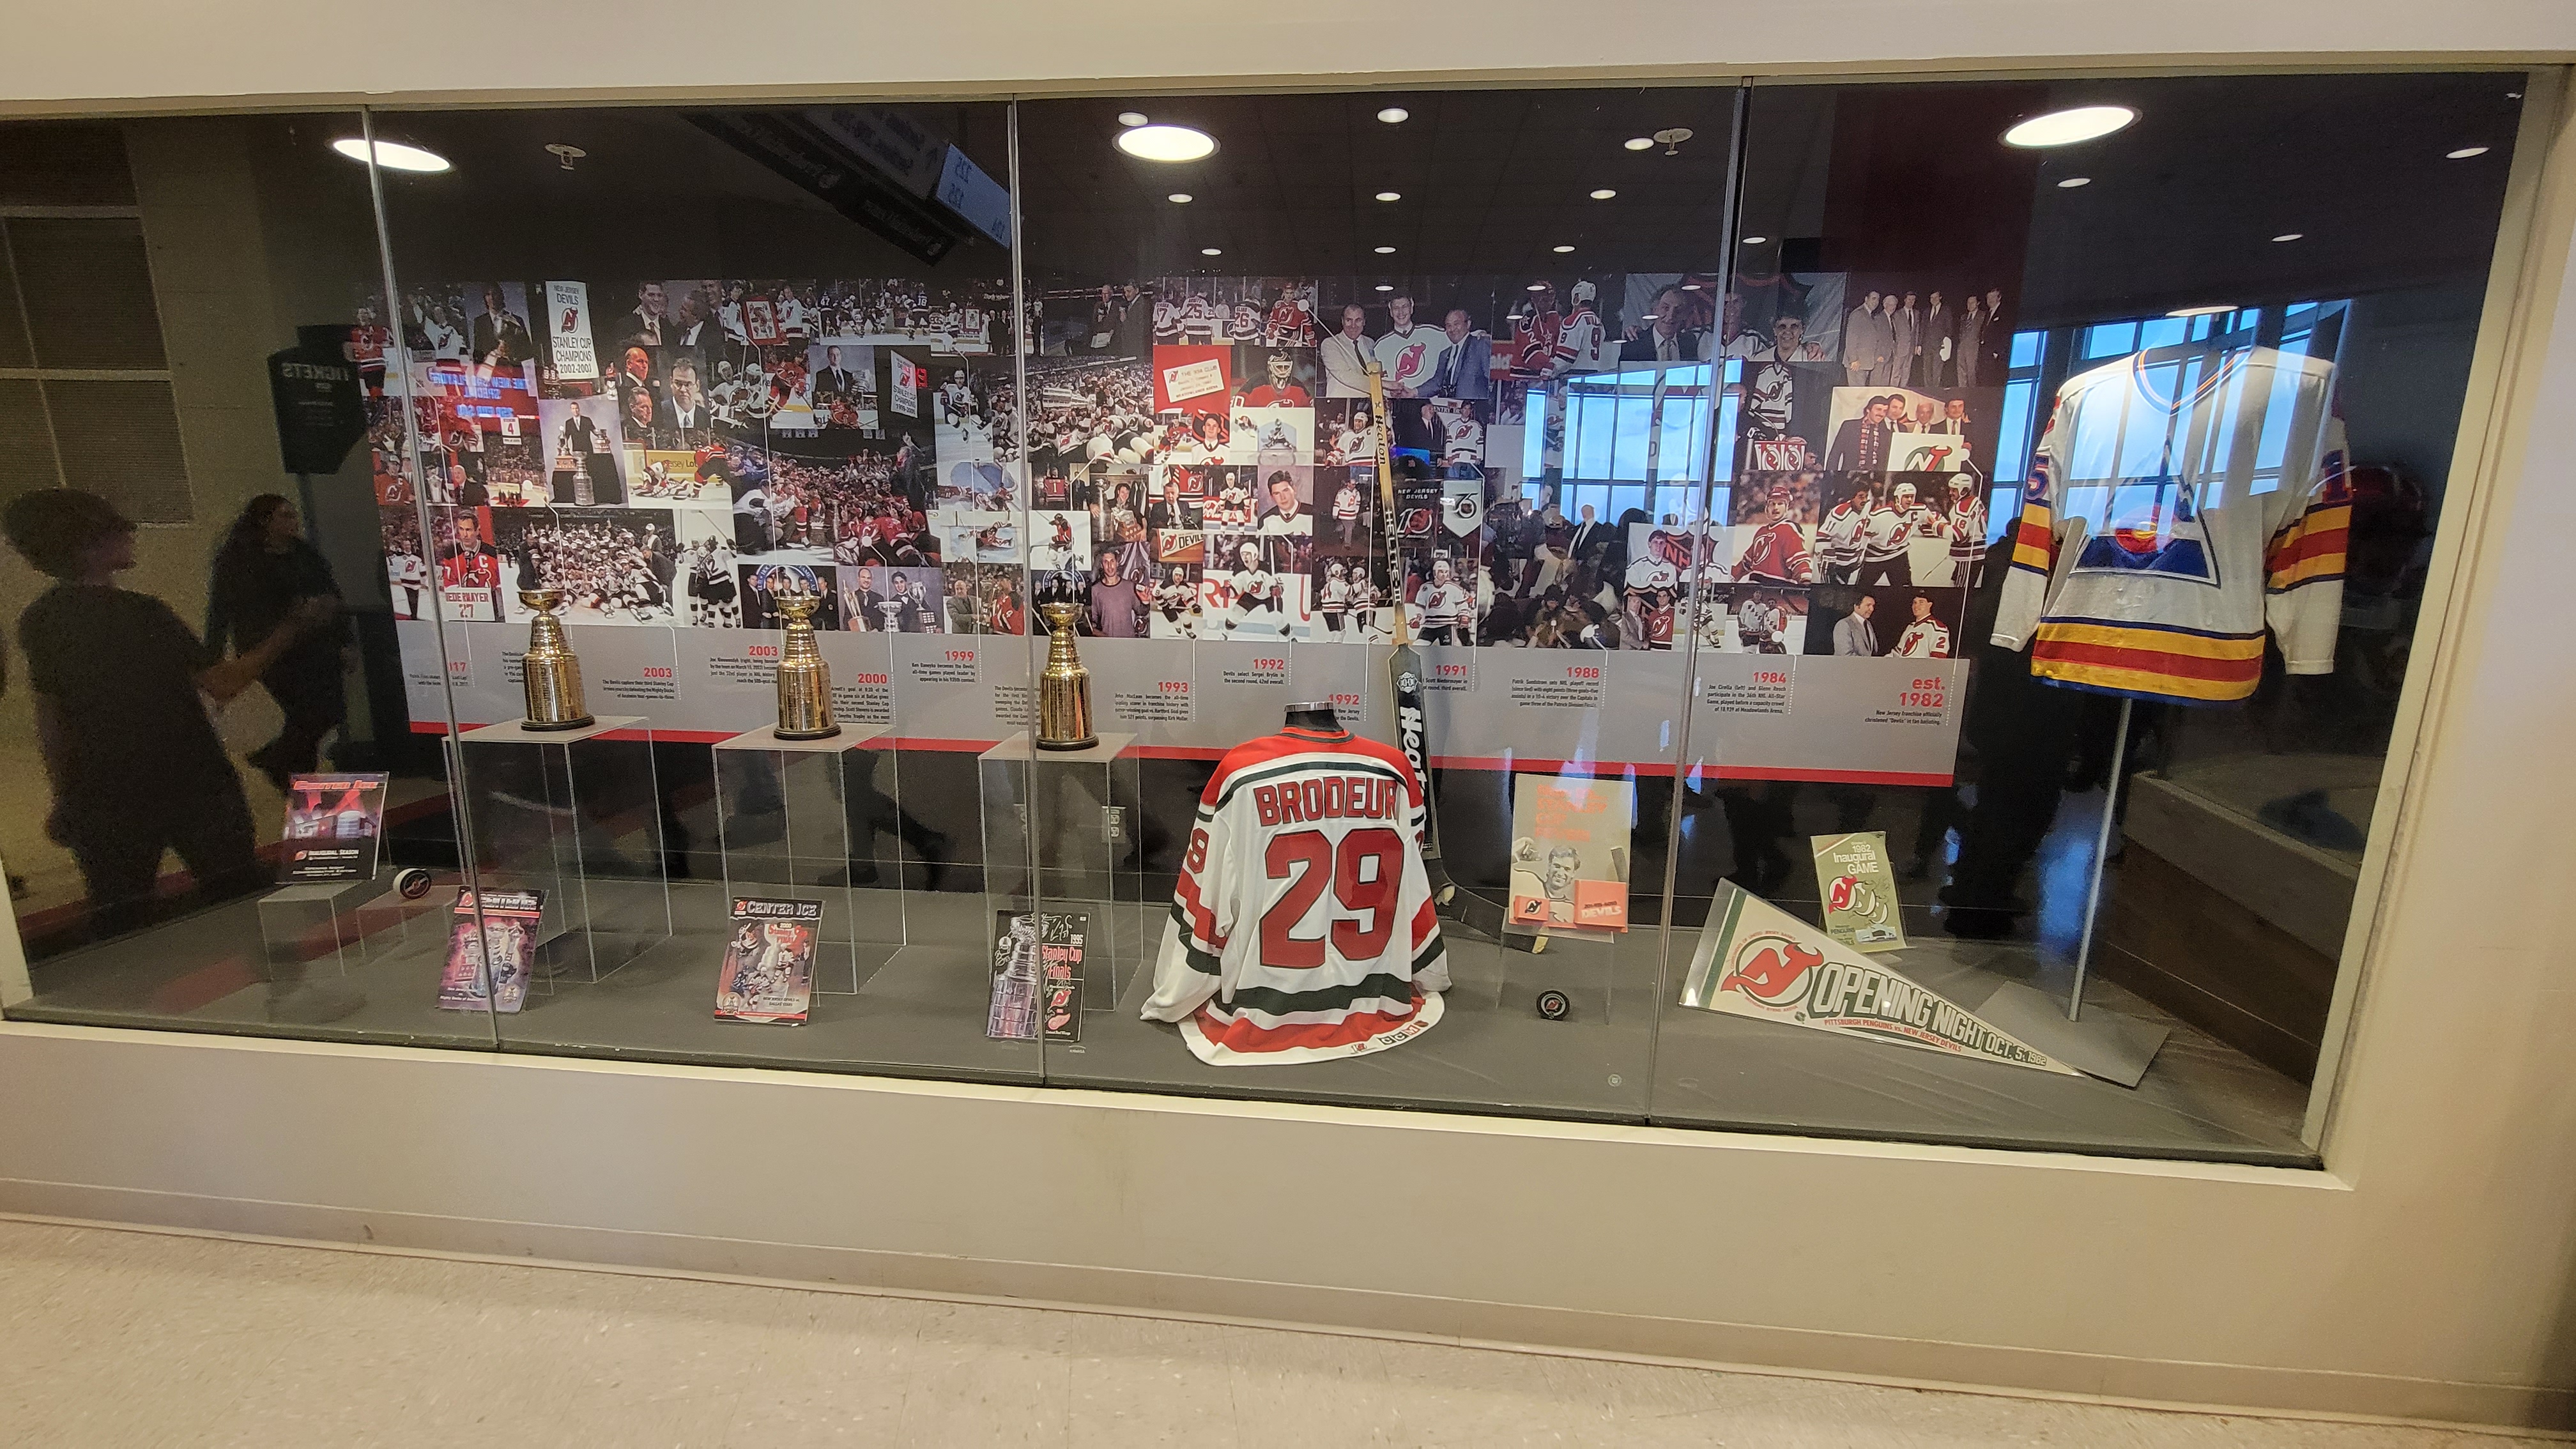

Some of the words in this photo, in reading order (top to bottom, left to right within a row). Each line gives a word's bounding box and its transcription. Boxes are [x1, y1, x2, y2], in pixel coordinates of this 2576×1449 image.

[556, 293, 579, 305] DEVILS
[1186, 303, 1202, 319] 25
[553, 336, 578, 349] STANLEY
[579, 337, 592, 349] CUP
[556, 350, 592, 362] CHAMPIONS
[507, 423, 514, 435] 4
[1374, 415, 1386, 466] Heaton
[1911, 513, 1917, 522] C
[1825, 521, 1837, 532] 11
[1179, 533, 1204, 549] DEVILS
[479, 555, 488, 568] C
[459, 604, 474, 618] 27
[749, 645, 778, 656] 2003
[946, 650, 974, 661] 1999
[1254, 659, 1284, 670] 1992
[1436, 665, 1467, 676] 1991
[643, 667, 672, 678] 2003
[858, 673, 887, 684] 2000
[1567, 666, 1600, 678] 1988
[1753, 671, 1786, 683] 1984
[1158, 681, 1188, 693] 1993
[1912, 677, 1945, 690] est.
[1329, 694, 1360, 705] 1992
[1899, 692, 1943, 707] 1982
[1254, 776, 1399, 827] BRODEUR
[1185, 827, 1209, 875] 9
[1852, 844, 1872, 853] 1982
[1833, 850, 1876, 864] Inaugural
[1847, 862, 1879, 874] GAME
[1259, 828, 1405, 970] 29
[746, 900, 794, 915] CENTER
[796, 903, 817, 916] ICE
[1581, 905, 1622, 919] DEVILS
[1070, 933, 1084, 945] 1995
[1042, 945, 1068, 965] Stanley
[1069, 946, 1083, 965] Cup
[1048, 963, 1072, 980] Finals
[1807, 962, 1935, 1029] OPENING
[1926, 999, 1988, 1050] NIGHT
[1981, 1031, 2013, 1059] OCT.
[2025, 1050, 2047, 1066] 1982
[1377, 1024, 1420, 1045] CCM
[1862, 1019, 1893, 1030] PENGUINS
[1903, 1027, 1919, 1036] NEW
[1919, 1031, 1940, 1045] JERSEY
[1940, 1038, 1962, 1052] DEVILS
